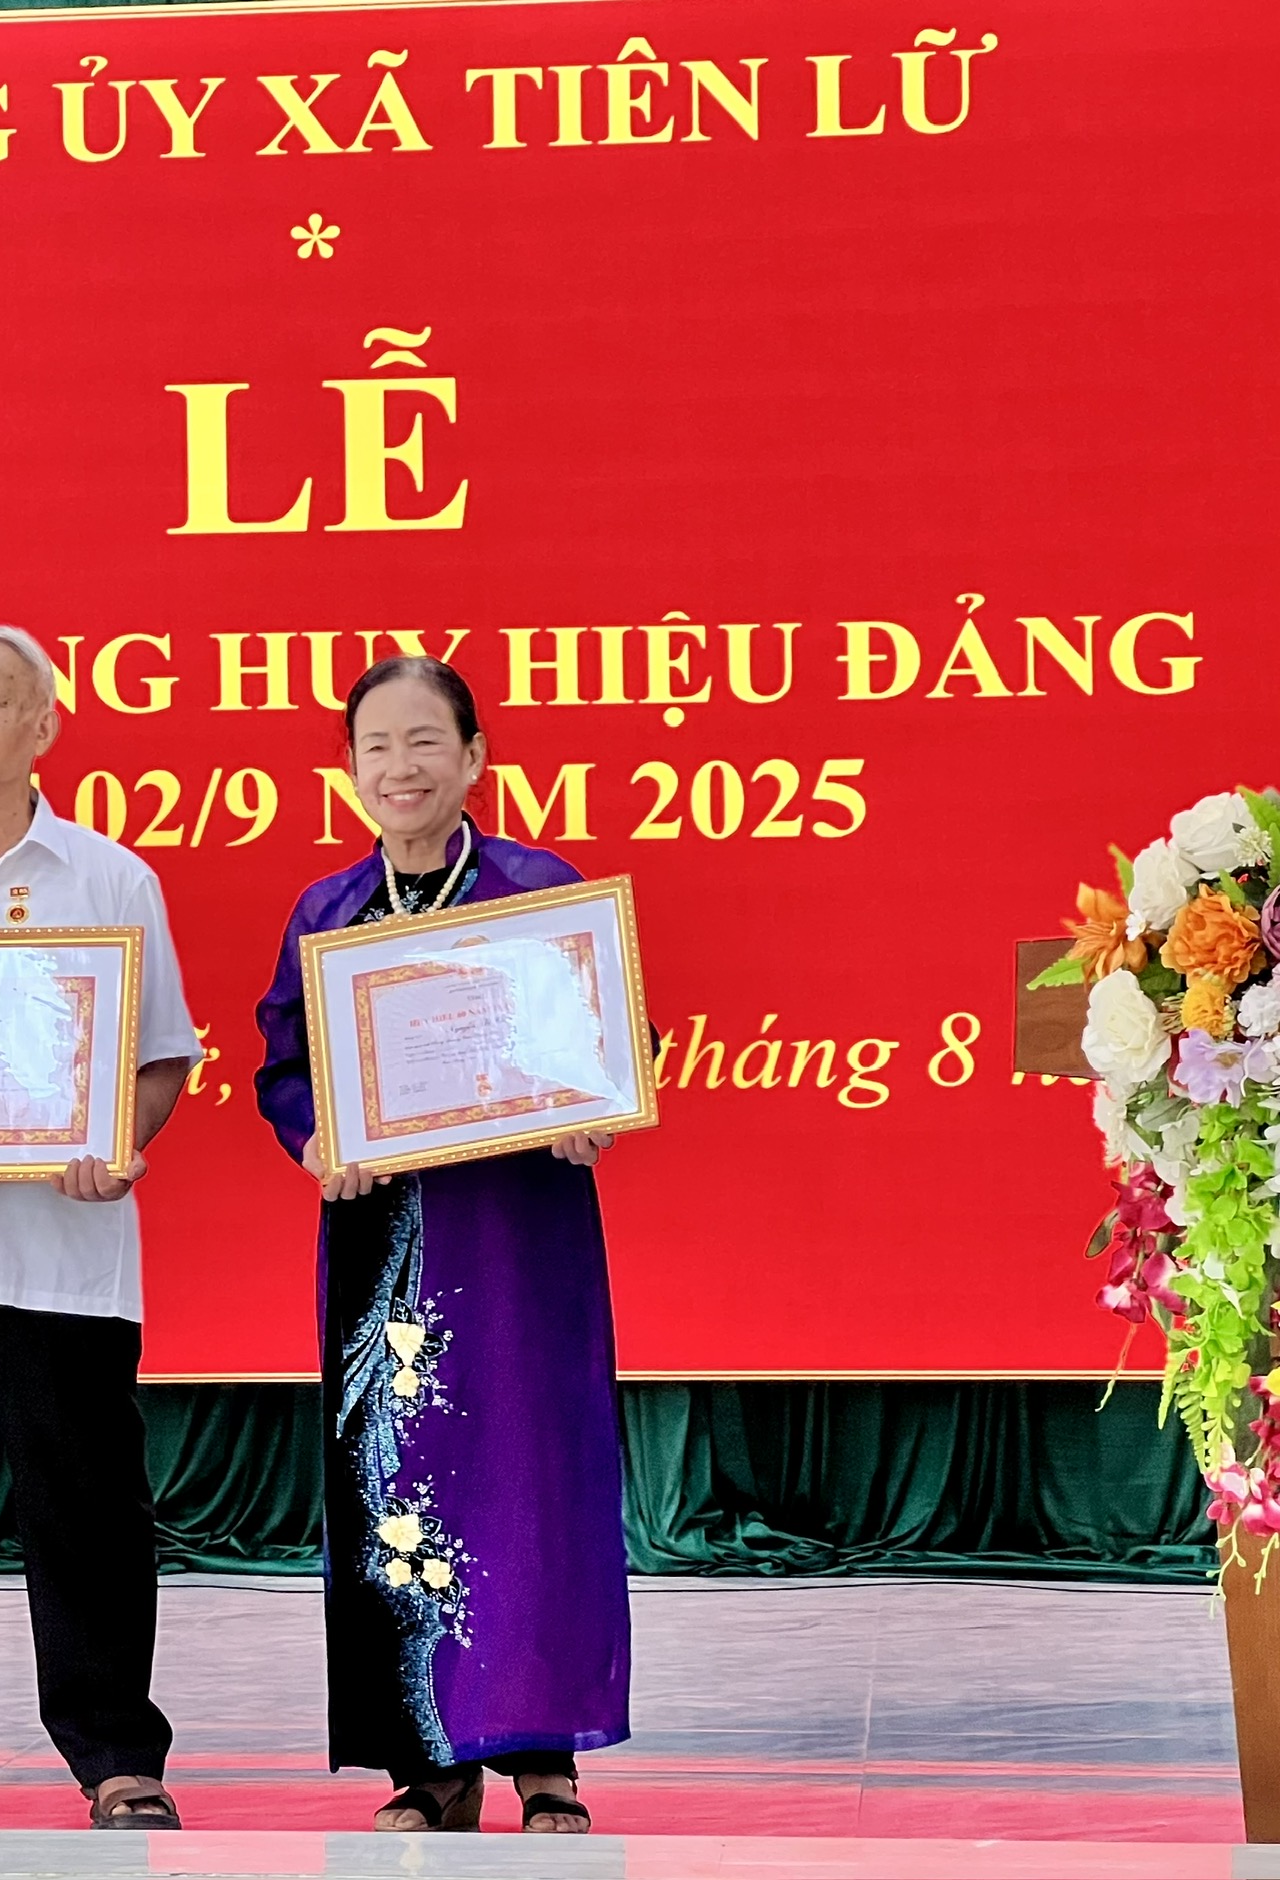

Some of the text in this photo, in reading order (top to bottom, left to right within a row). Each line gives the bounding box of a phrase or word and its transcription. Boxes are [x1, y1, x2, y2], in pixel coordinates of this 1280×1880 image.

[52, 55, 226, 163] ỦY
[255, 49, 433, 156] XÃ
[465, 36, 769, 149] TIÊN
[805, 27, 999, 138] LỮ
[164, 326, 469, 535] LỄ
[498, 610, 803, 728] HIỆU
[836, 592, 1204, 700] ĐẢNG
[74, 767, 278, 848] 02/9
[312, 763, 597, 844] NM
[630, 758, 867, 840] 2025
[653, 1012, 981, 1109] tháng 8
